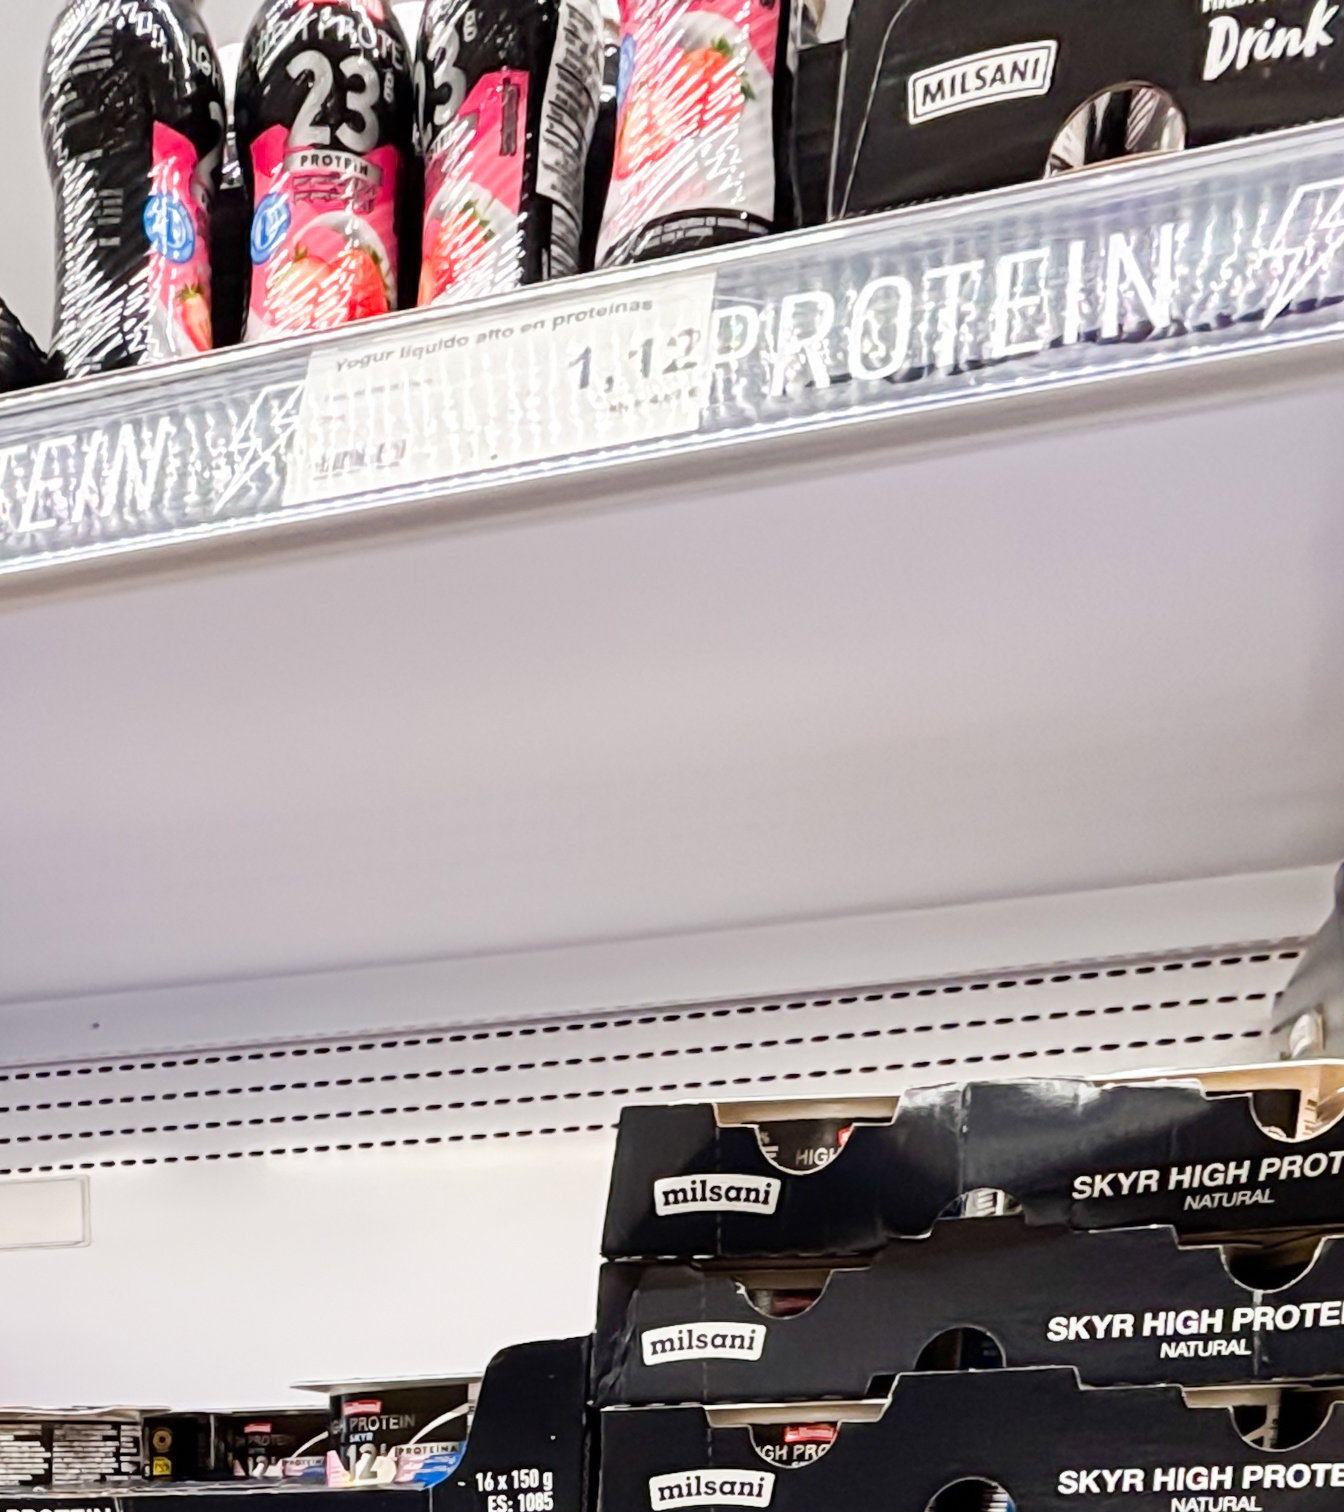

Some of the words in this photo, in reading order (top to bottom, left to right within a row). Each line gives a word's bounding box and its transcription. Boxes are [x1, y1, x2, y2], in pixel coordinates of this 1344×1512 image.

[1203, 2, 1338, 82] Drink
[919, 55, 1043, 110] MILSANI
[286, 49, 380, 153] 23
[711, 223, 1180, 395] PROTEIN
[1072, 1170, 1160, 1201] SKYR
[1169, 1155, 1250, 1191] HIGH
[662, 1180, 773, 1210] milsani
[1184, 1188, 1275, 1212] NATURAL
[1047, 1313, 1133, 1342] SKYR
[1143, 1307, 1223, 1338] HIGH
[650, 1330, 757, 1359] milsani
[1160, 1338, 1252, 1359] NATURAL
[512, 1470, 538, 1490] 150
[658, 1477, 765, 1502] milsani
[1058, 1468, 1140, 1495] SKYR
[1153, 1464, 1234, 1492] HIGH
